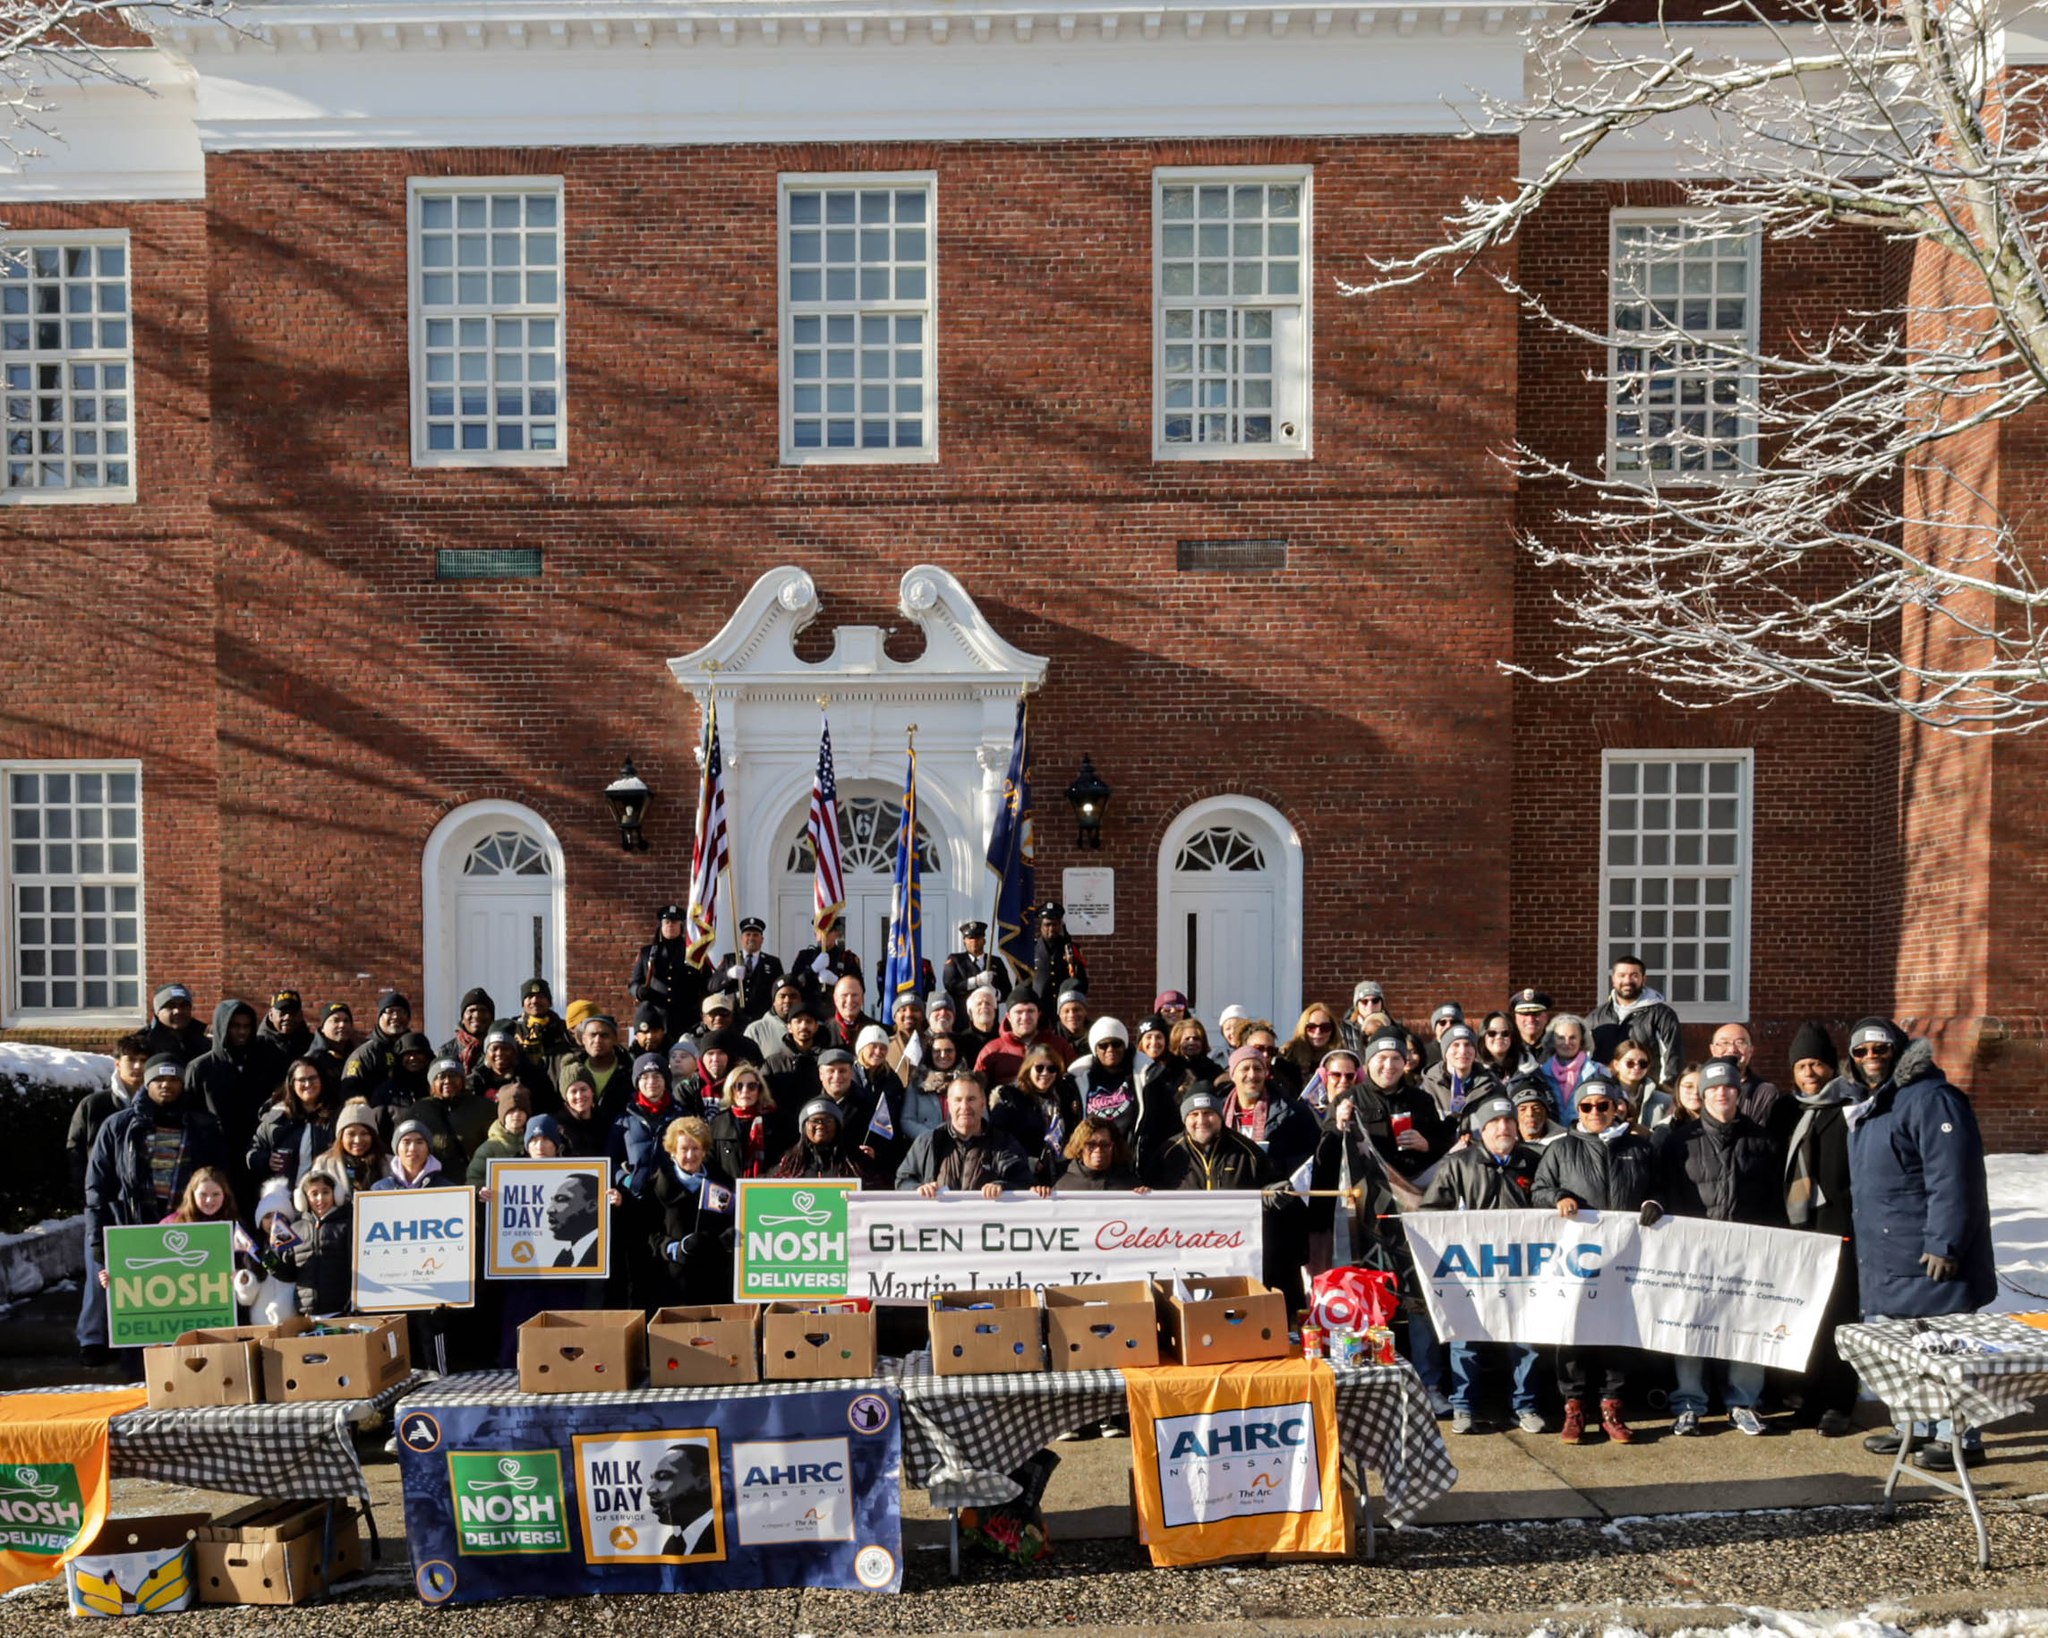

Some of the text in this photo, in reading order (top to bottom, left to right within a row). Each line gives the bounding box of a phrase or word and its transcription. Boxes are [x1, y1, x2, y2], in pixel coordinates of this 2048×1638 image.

[856, 813, 871, 836] 6
[504, 1185, 544, 1205] MLK
[503, 1207, 544, 1228] DAY
[365, 1217, 464, 1243] AHRC
[869, 1220, 1245, 1252] GLEN COVE Celebrates
[363, 1245, 465, 1256] NASSAU
[748, 1231, 845, 1262] NOSH
[1432, 1243, 1602, 1278] AHRC
[747, 1272, 847, 1288] DELIVERS!
[1656, 1269, 1686, 1278] people
[1699, 1273, 1714, 1281] live
[115, 1272, 229, 1309] NOSH
[1756, 1291, 1805, 1307] Community
[1169, 1418, 1306, 1459] AHRC
[591, 1460, 643, 1486] MLK
[743, 1461, 844, 1487] AHRC
[1169, 1457, 1308, 1476] NASSAU
[594, 1487, 643, 1513] DAY
[743, 1487, 845, 1499] NASSAU
[1239, 1489, 1272, 1498] The Arc
[0, 1500, 80, 1529] NOSH
[460, 1494, 556, 1523] NOSH
[595, 1513, 646, 1522] OF SERVICE
[465, 1530, 562, 1546] DELIVERS!
